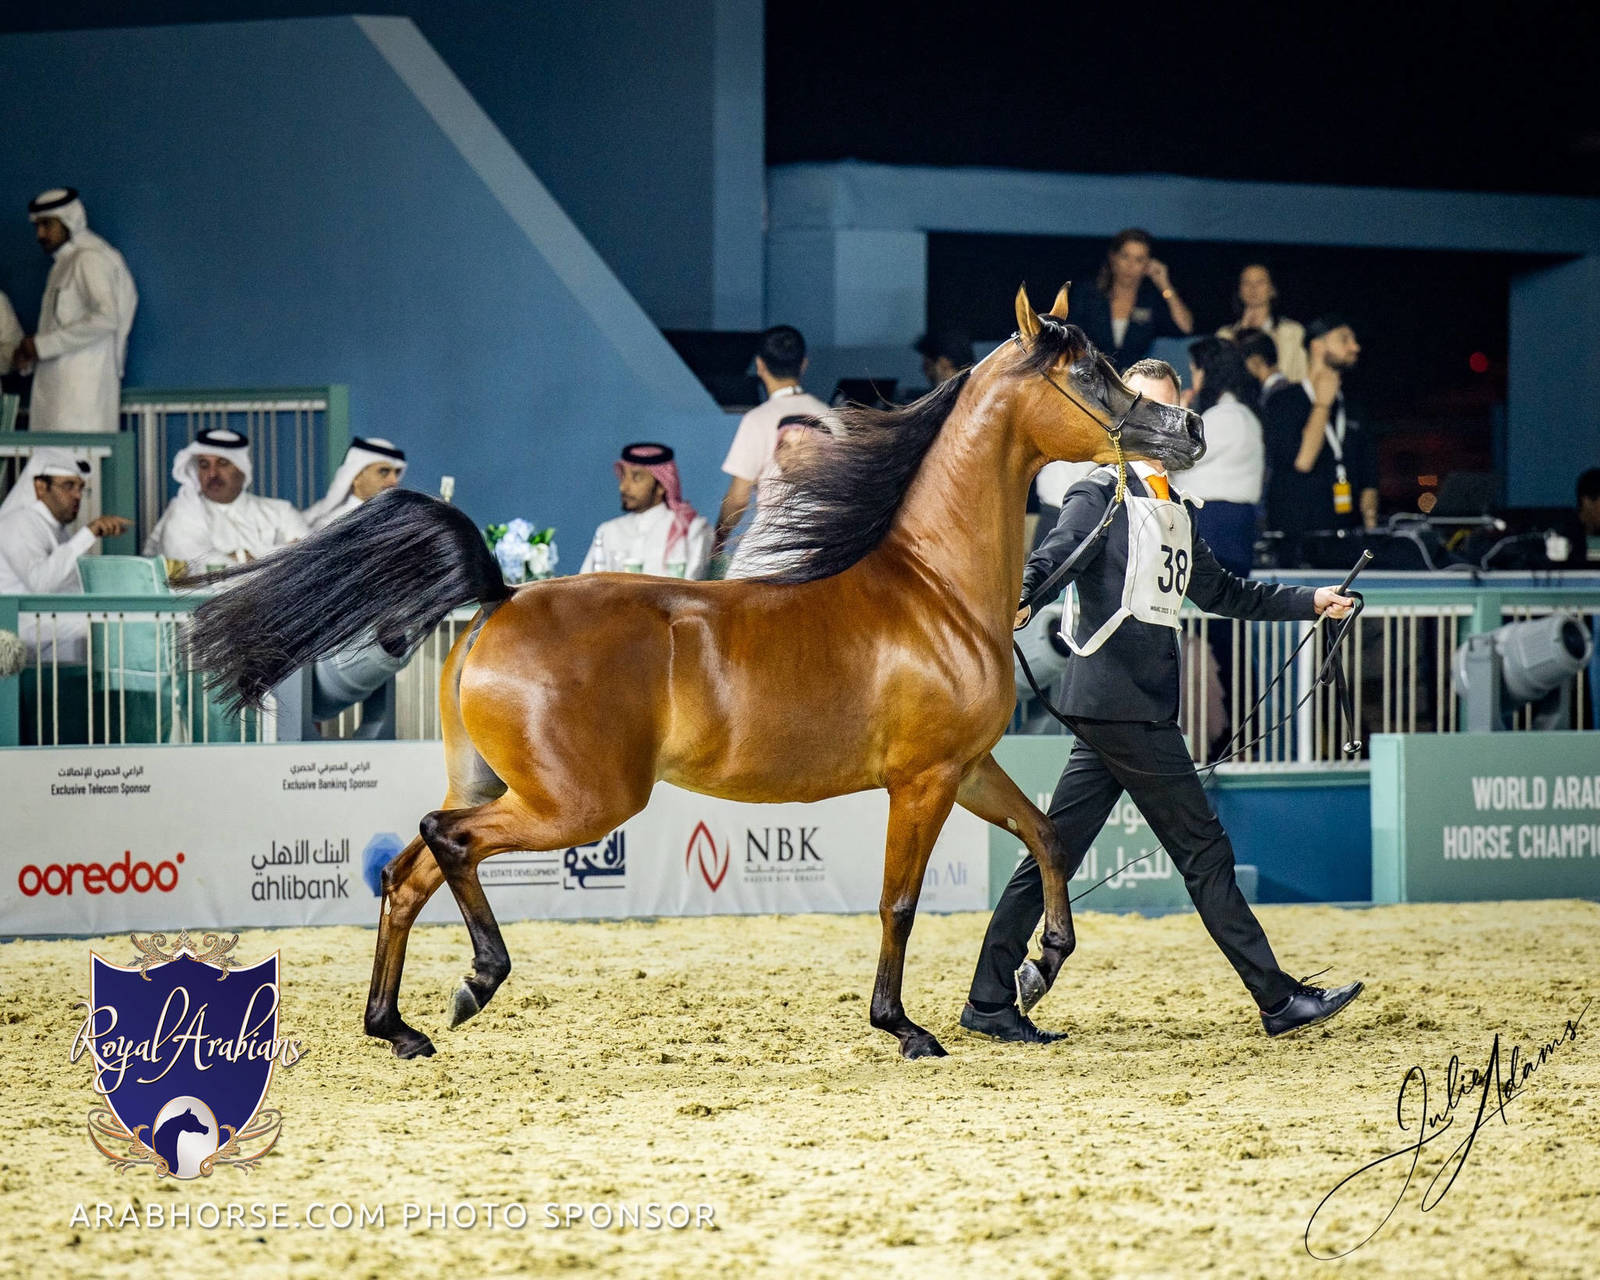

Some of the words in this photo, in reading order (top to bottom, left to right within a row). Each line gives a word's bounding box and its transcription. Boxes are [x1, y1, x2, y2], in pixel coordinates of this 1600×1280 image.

[1158, 545, 1188, 597] 38
[51, 784, 86, 795] Exclusive
[87, 783, 119, 794] Telecom
[120, 782, 151, 796] Sponsor
[282, 778, 317, 790] Exclusive
[318, 778, 347, 791] Banking
[349, 777, 378, 791] Sponsor
[1472, 776, 1547, 810] WORLD
[313, 838, 350, 869] البنك
[745, 826, 823, 862] NBK
[1443, 825, 1513, 860] HORSE
[1518, 824, 1600, 858] CHAMPI
[18, 850, 186, 897] ooredoo
[251, 874, 349, 901] ahlibank
